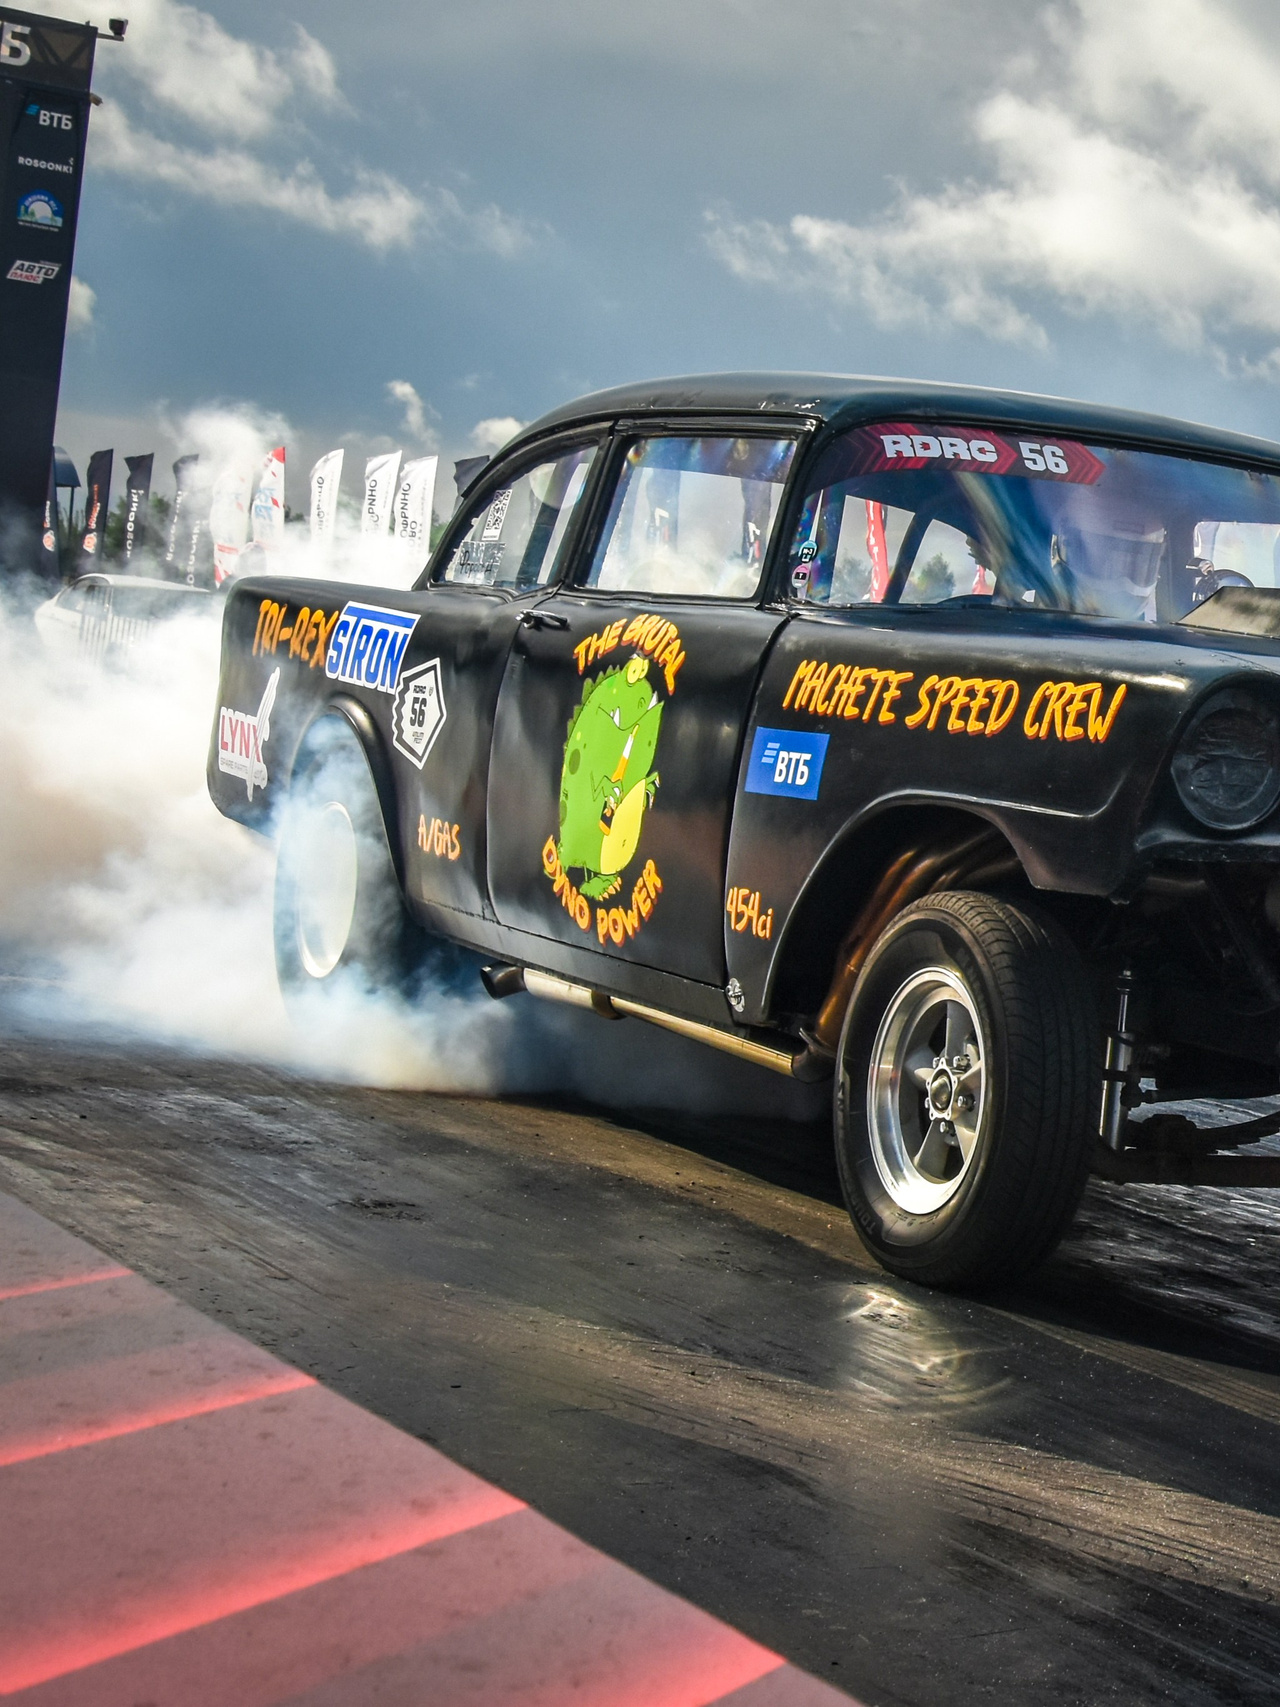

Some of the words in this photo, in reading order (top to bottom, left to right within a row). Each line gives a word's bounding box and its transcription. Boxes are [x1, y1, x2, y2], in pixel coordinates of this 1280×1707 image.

[38, 109, 73, 131] ВТБ
[18, 156, 73, 174] ROSGONKI
[14, 262, 56, 277] АВТО
[880, 434, 998, 463] RDRC
[1018, 441, 1069, 474] 56
[252, 599, 339, 670] TRI-REX
[573, 618, 628, 675] THE
[621, 612, 686, 695] BRUTAL
[409, 697, 428, 728] 56
[783, 659, 914, 727] MACHETE
[904, 673, 1020, 737] SPEED
[1023, 681, 1128, 743] CREW
[220, 714, 261, 764] LYNX
[774, 750, 812, 786] ВТБ
[417, 814, 462, 860] A/GAS
[542, 834, 592, 933] DYNO
[597, 859, 664, 948] POWER
[725, 887, 774, 940] 454ci
